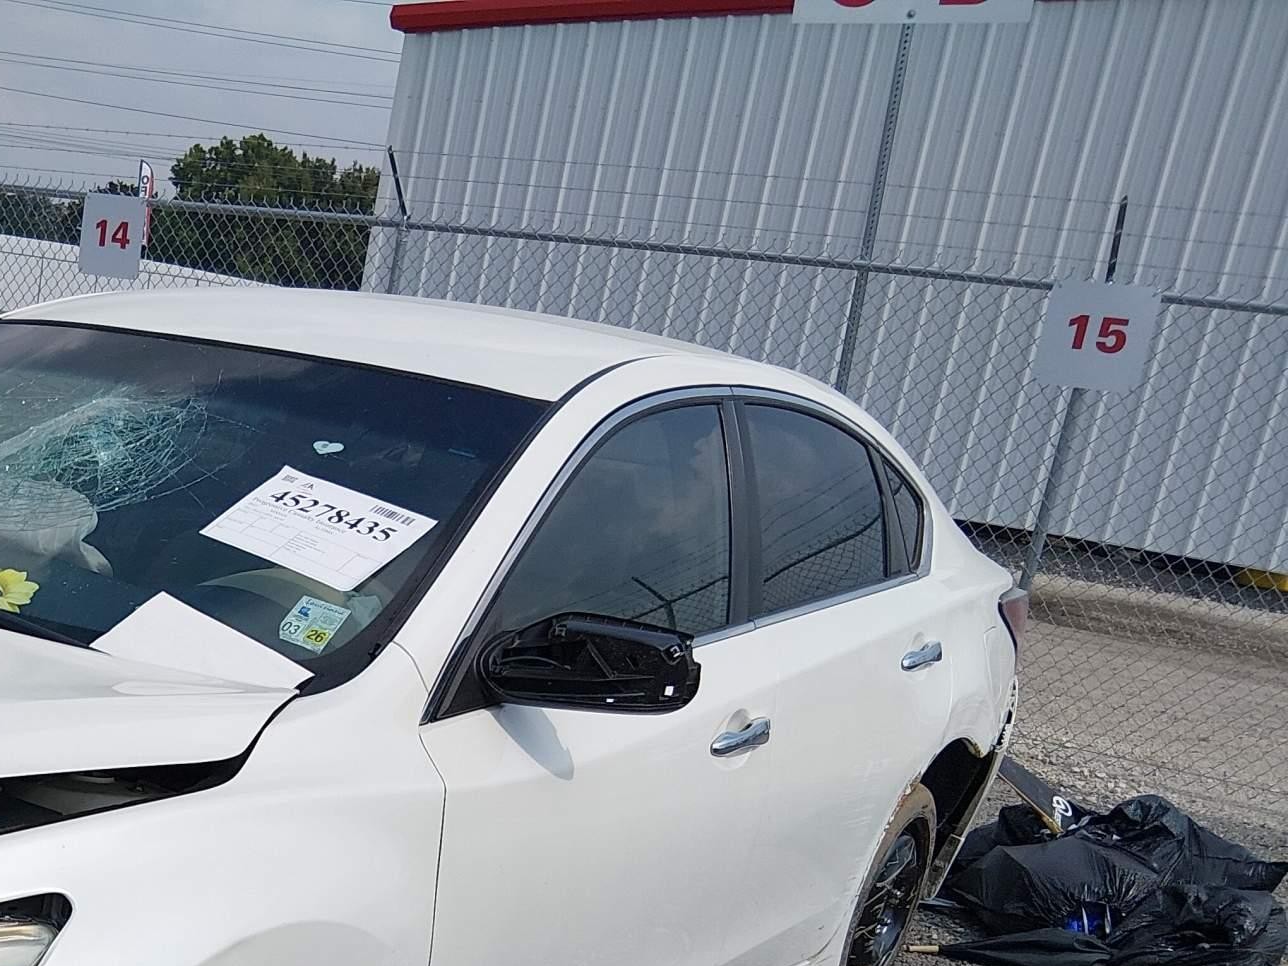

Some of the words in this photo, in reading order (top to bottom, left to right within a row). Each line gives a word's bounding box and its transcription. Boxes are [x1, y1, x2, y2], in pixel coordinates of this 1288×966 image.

[95, 219, 130, 250] 14
[1068, 314, 1130, 354] 15
[270, 490, 398, 542] 45278435
[281, 621, 301, 635] 03
[306, 629, 327, 643] 26
